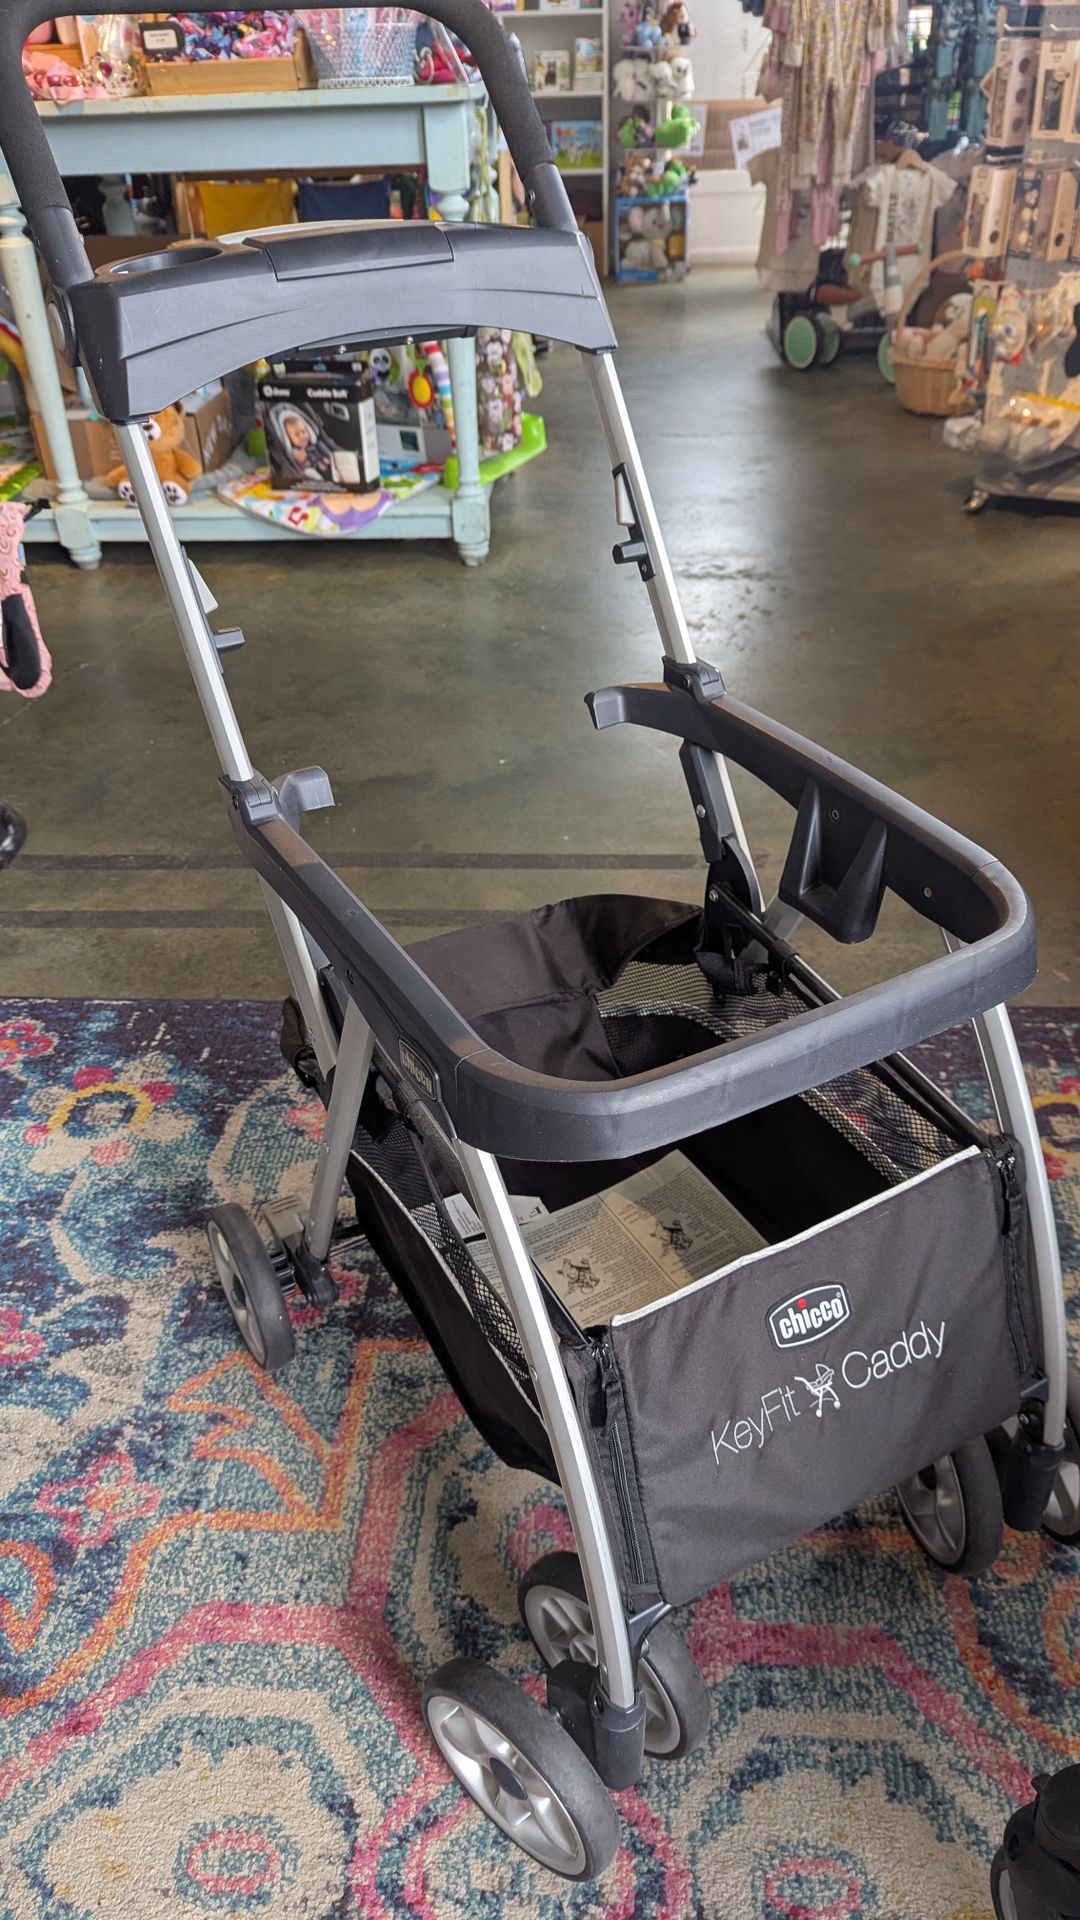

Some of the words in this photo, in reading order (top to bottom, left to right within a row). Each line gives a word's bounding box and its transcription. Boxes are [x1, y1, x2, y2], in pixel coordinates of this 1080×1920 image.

[779, 1298, 844, 1340] chicco
[711, 1386, 801, 1465] KeyFit
[841, 1320, 946, 1389] Caddy
